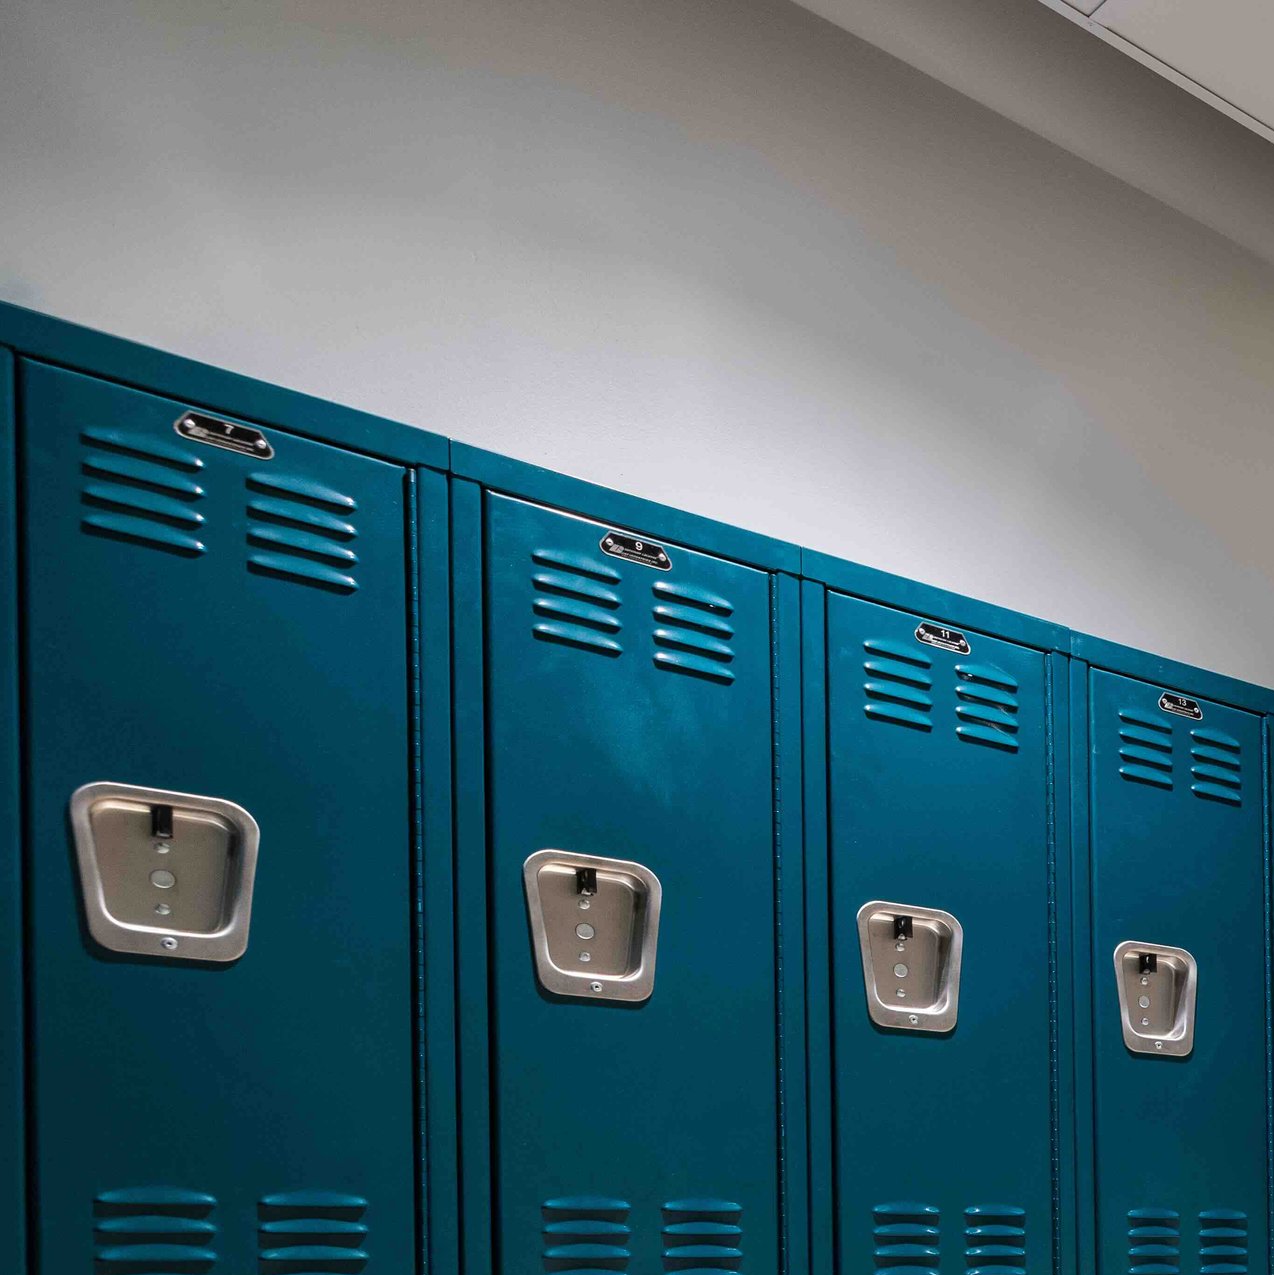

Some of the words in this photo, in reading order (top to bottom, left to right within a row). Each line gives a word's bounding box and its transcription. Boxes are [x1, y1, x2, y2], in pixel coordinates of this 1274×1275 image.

[224, 423, 235, 435] 7
[635, 541, 643, 551] 9
[940, 630, 950, 639] 11
[1178, 698, 1187, 707] 13
